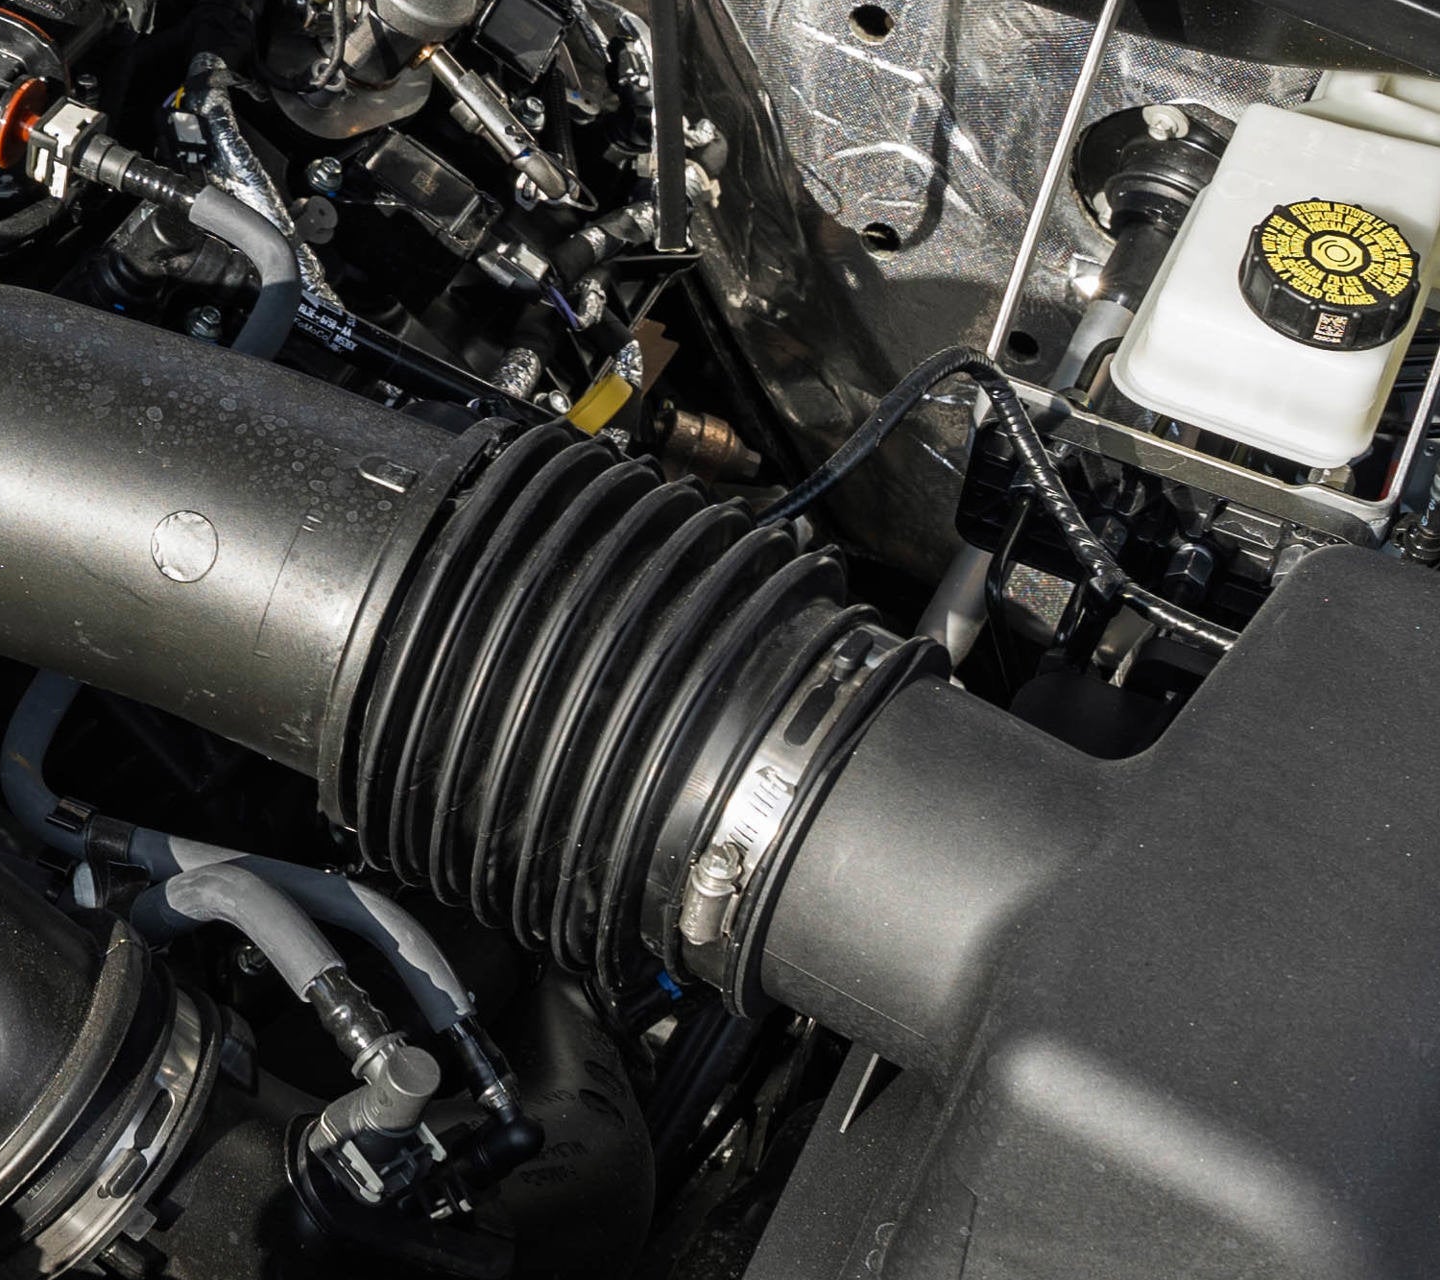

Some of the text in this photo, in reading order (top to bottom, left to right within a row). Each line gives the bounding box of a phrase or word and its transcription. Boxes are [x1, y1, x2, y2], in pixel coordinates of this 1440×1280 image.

[1294, 258, 1327, 281] CLEAN
[1325, 273, 1362, 286] FILLER
[1285, 276, 1324, 300] SEALED
[1323, 292, 1379, 305] CONTAINER
[1320, 281, 1340, 295] USE
